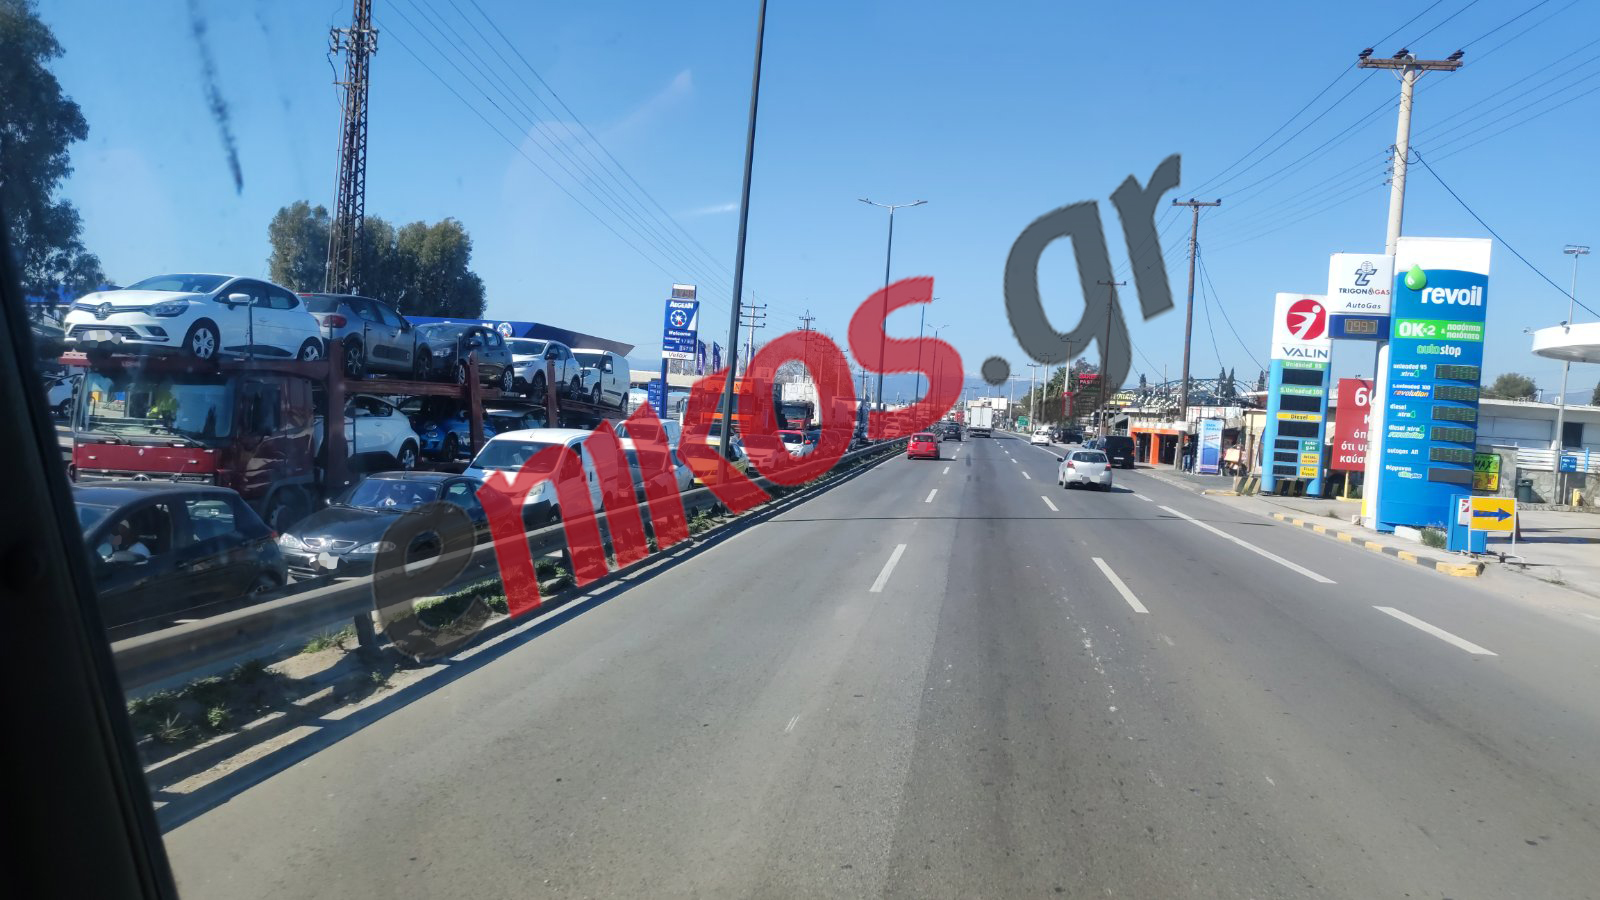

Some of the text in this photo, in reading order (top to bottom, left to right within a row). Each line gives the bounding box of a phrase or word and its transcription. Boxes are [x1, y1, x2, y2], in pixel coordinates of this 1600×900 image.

[1339, 287, 1368, 295] TRIGON
[1421, 286, 1482, 306] revoil
[1346, 302, 1381, 310] AutoGas
[1282, 346, 1328, 359] VALIN
[1339, 454, 1366, 464] καύσ
